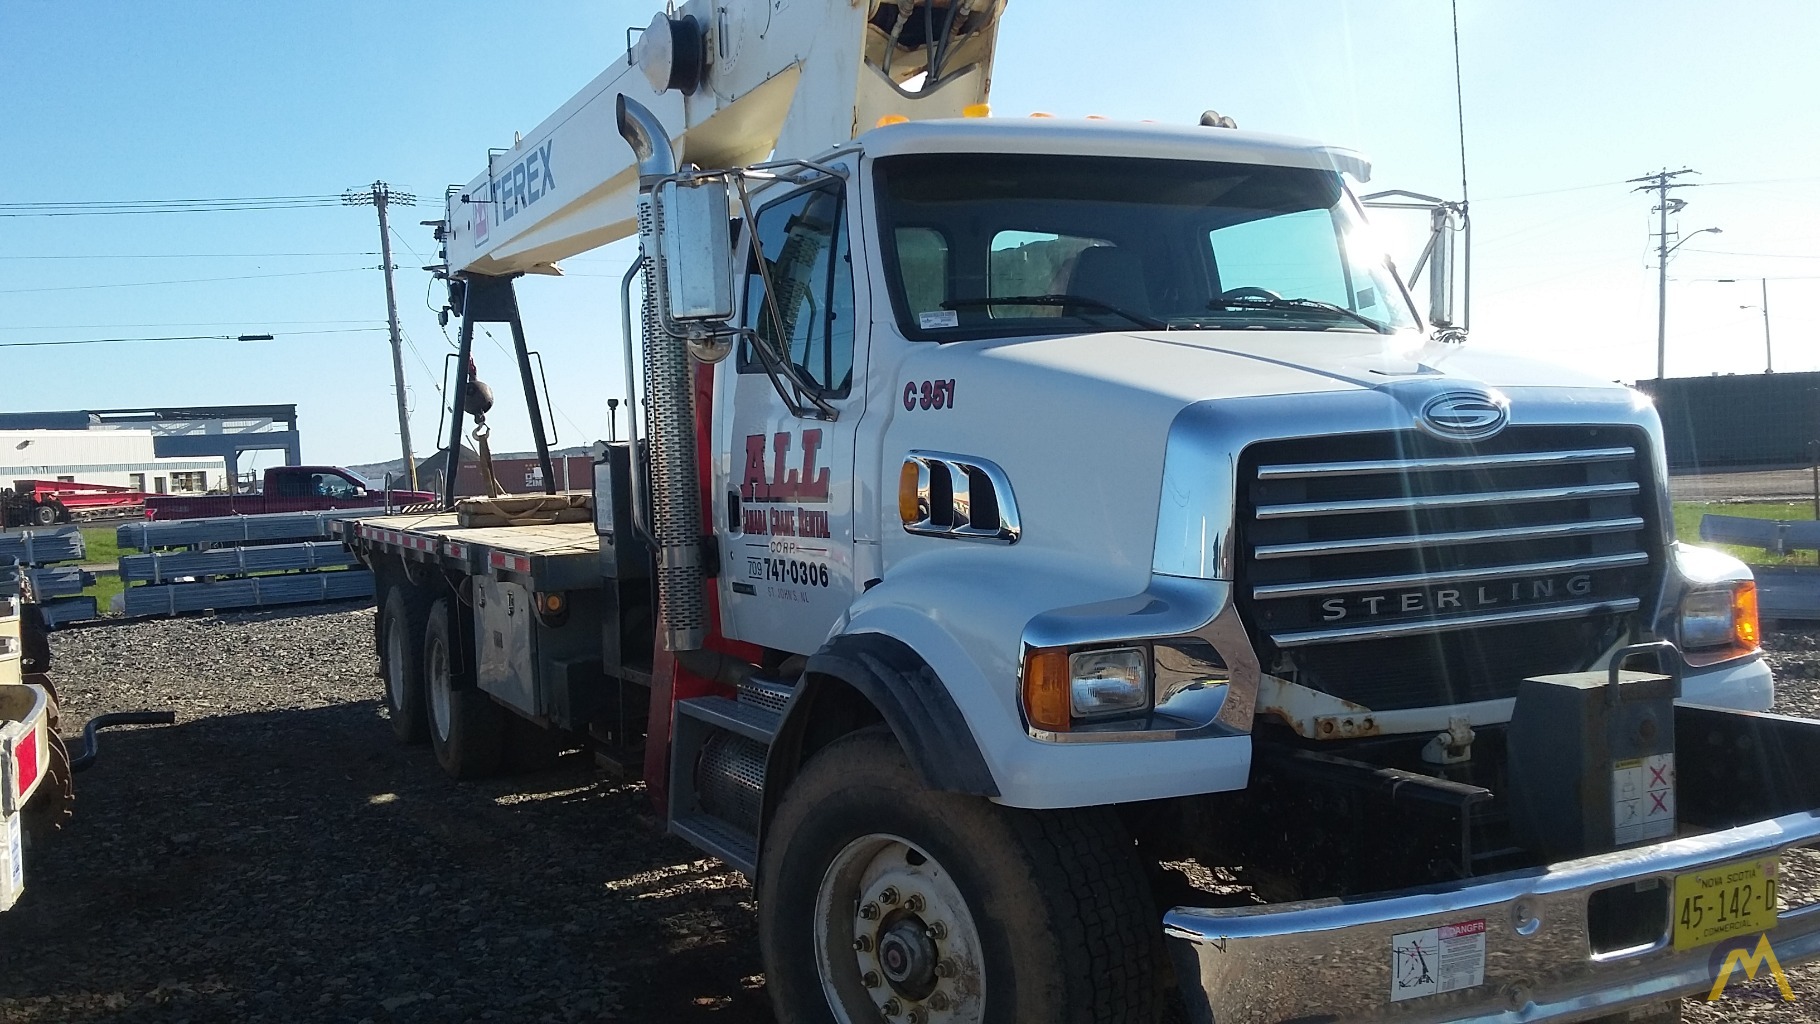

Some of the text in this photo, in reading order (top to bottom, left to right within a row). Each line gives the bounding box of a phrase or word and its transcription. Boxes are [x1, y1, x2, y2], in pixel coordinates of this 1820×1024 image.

[492, 139, 556, 227] TEREX
[903, 379, 955, 411] C 351
[741, 428, 830, 503] ALL
[748, 560, 762, 576] 709
[1322, 574, 1591, 621] STERLING
[1701, 878, 1723, 889] NOVA
[1727, 869, 1756, 884] SCOTIA
[1681, 879, 1775, 930] 45-142-D
[1704, 920, 1752, 938] COMMERCIAL
